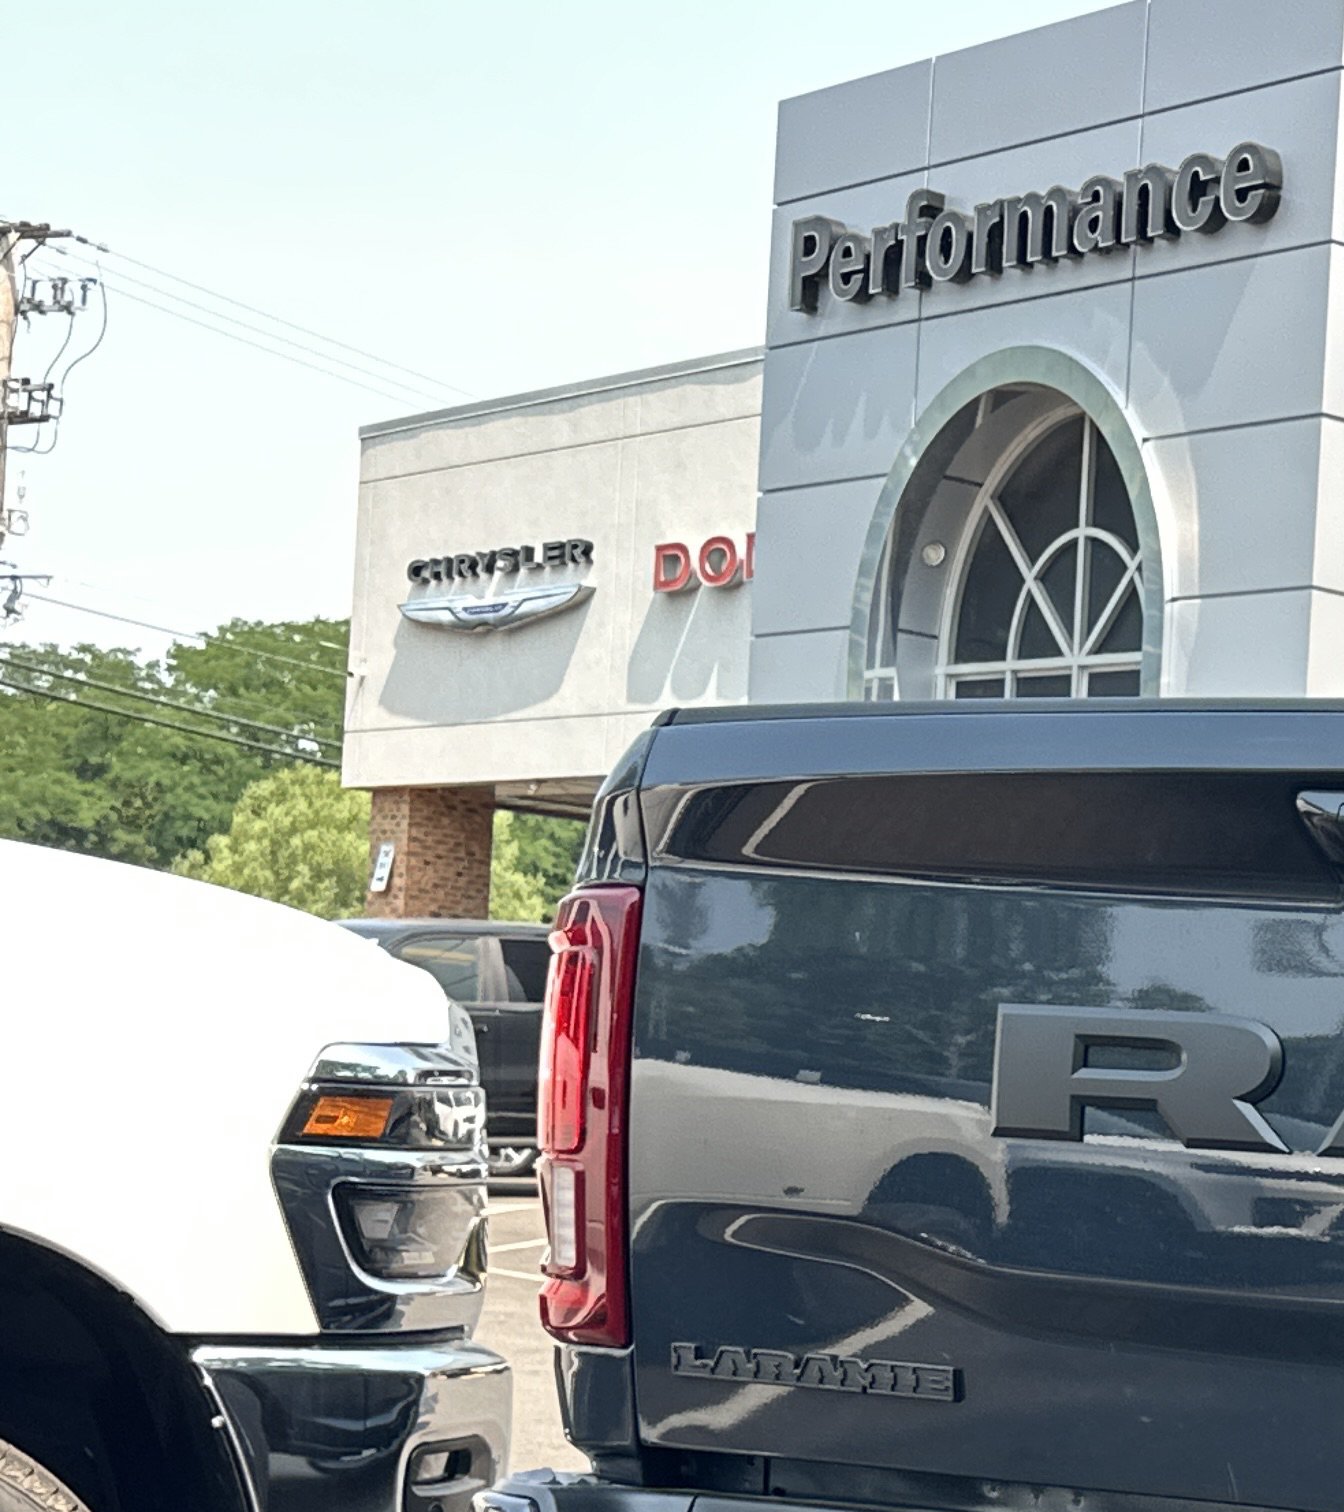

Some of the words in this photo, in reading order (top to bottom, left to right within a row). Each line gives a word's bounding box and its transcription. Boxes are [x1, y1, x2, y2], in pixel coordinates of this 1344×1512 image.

[789, 141, 1283, 315] Performance
[406, 538, 595, 584] CHRYSLER
[653, 532, 757, 593] DO
[670, 1342, 966, 1403] LARAMIE
